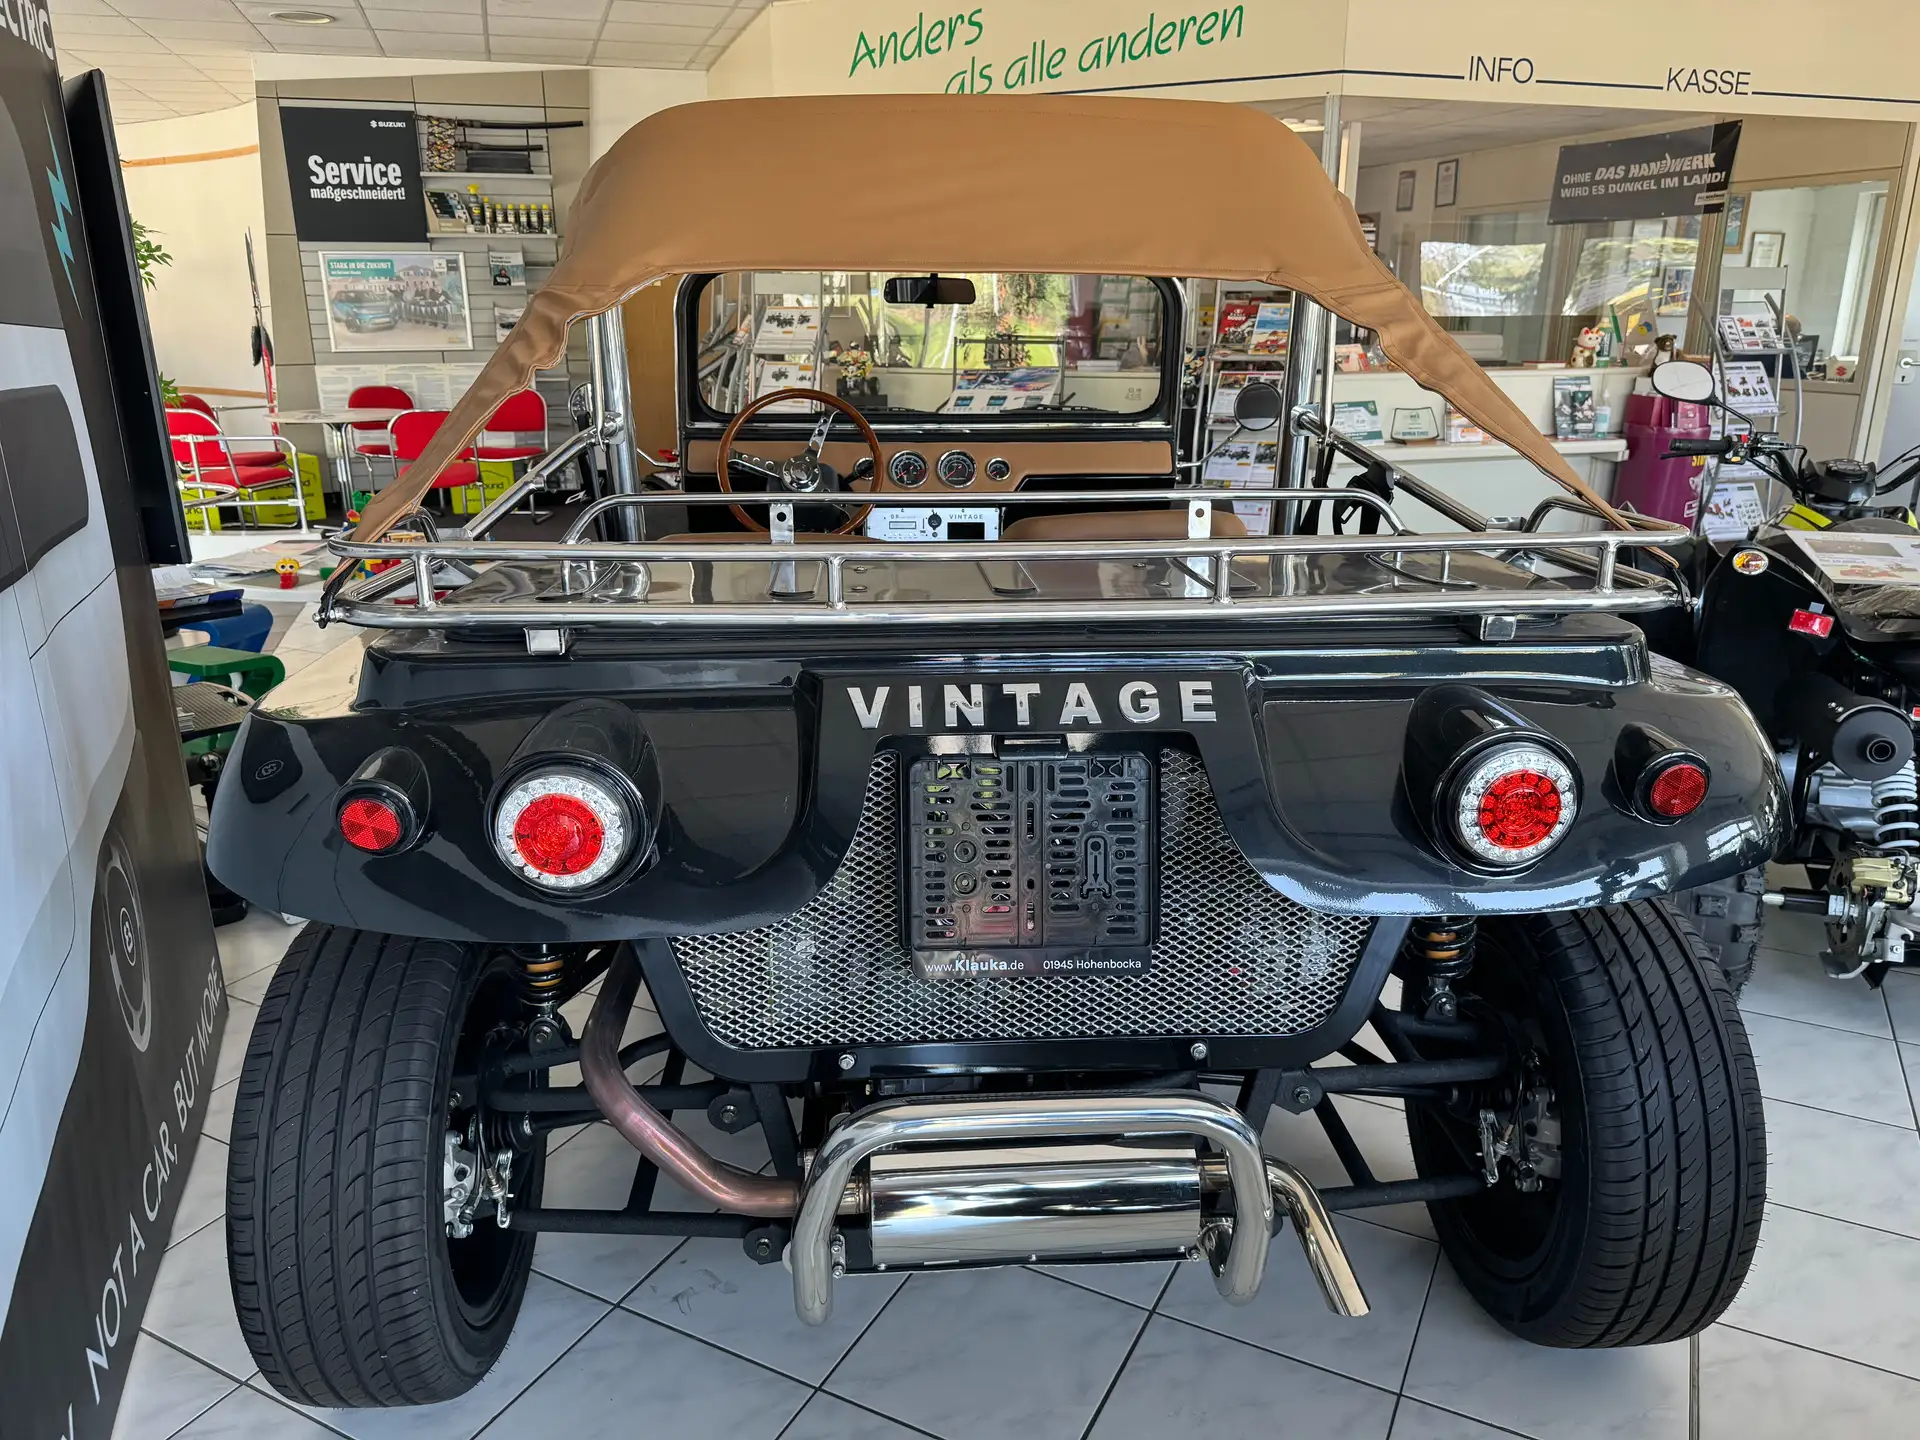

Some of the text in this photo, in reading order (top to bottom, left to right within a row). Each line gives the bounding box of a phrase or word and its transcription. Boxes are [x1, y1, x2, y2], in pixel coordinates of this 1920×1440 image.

[848, 7, 983, 78] Anders
[944, 4, 1244, 94] als alle anderen
[1469, 55, 1534, 84] INFO
[1666, 67, 1751, 96] KASSE
[307, 154, 402, 186] Service
[1560, 171, 1727, 198] WIRD ES DUNKEL IM LAND!
[1562, 172, 1592, 185] OHNE
[1594, 165, 1626, 181] DAS
[310, 185, 406, 202] maßgeschneidert!
[846, 680, 1217, 729] VINTAGE
[924, 958, 1142, 973] www.Klauka.de 01945 Hohenbocka
[85, 956, 223, 1406] NOT A CAR, BUT MORE.
